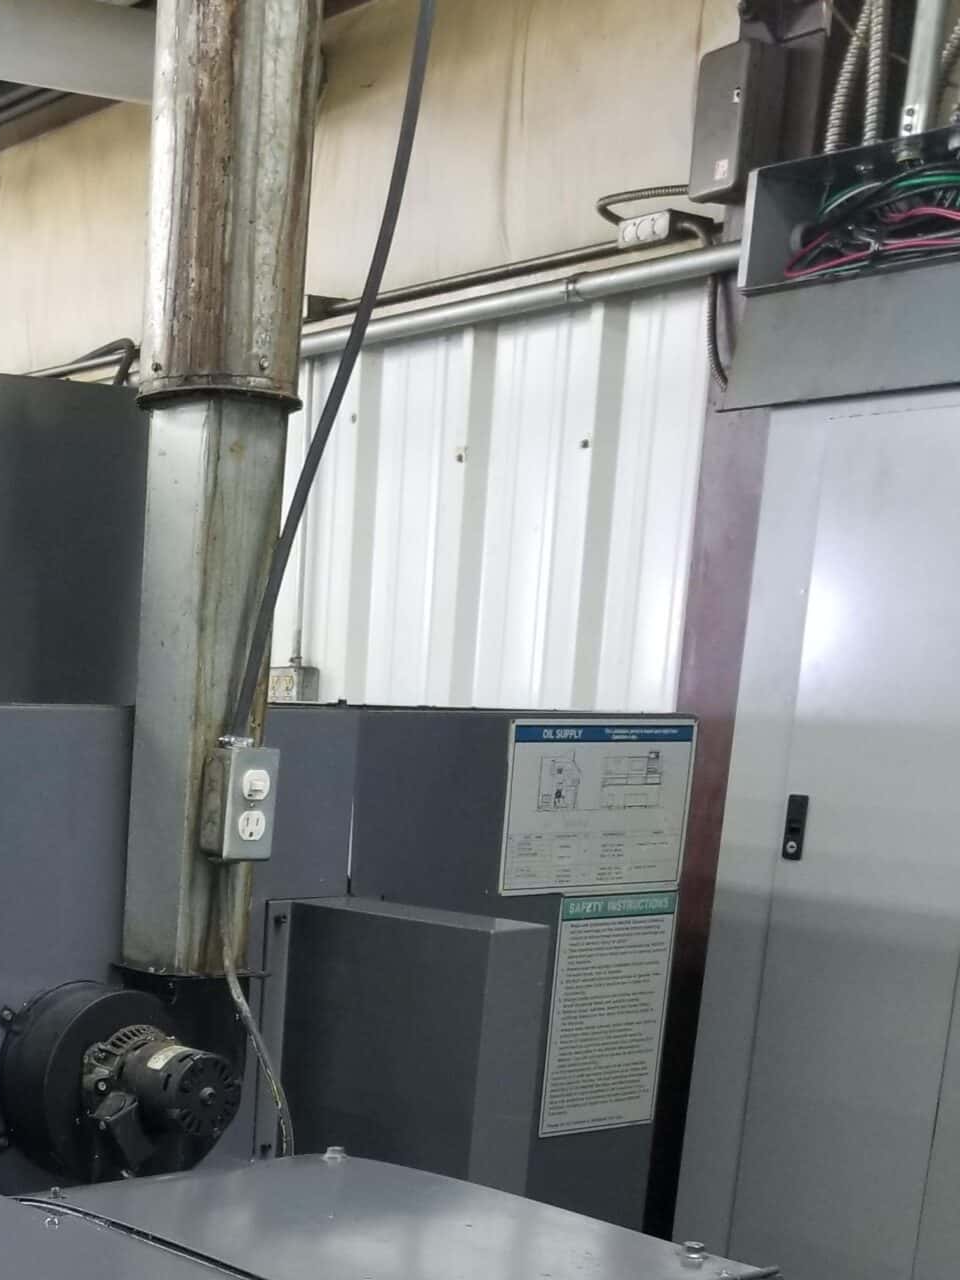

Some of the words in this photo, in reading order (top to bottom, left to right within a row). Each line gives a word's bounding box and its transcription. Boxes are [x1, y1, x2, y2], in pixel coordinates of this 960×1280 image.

[543, 729, 554, 739] OIL
[556, 729, 583, 738] SUPPLY
[569, 902, 603, 913] SAFETY
